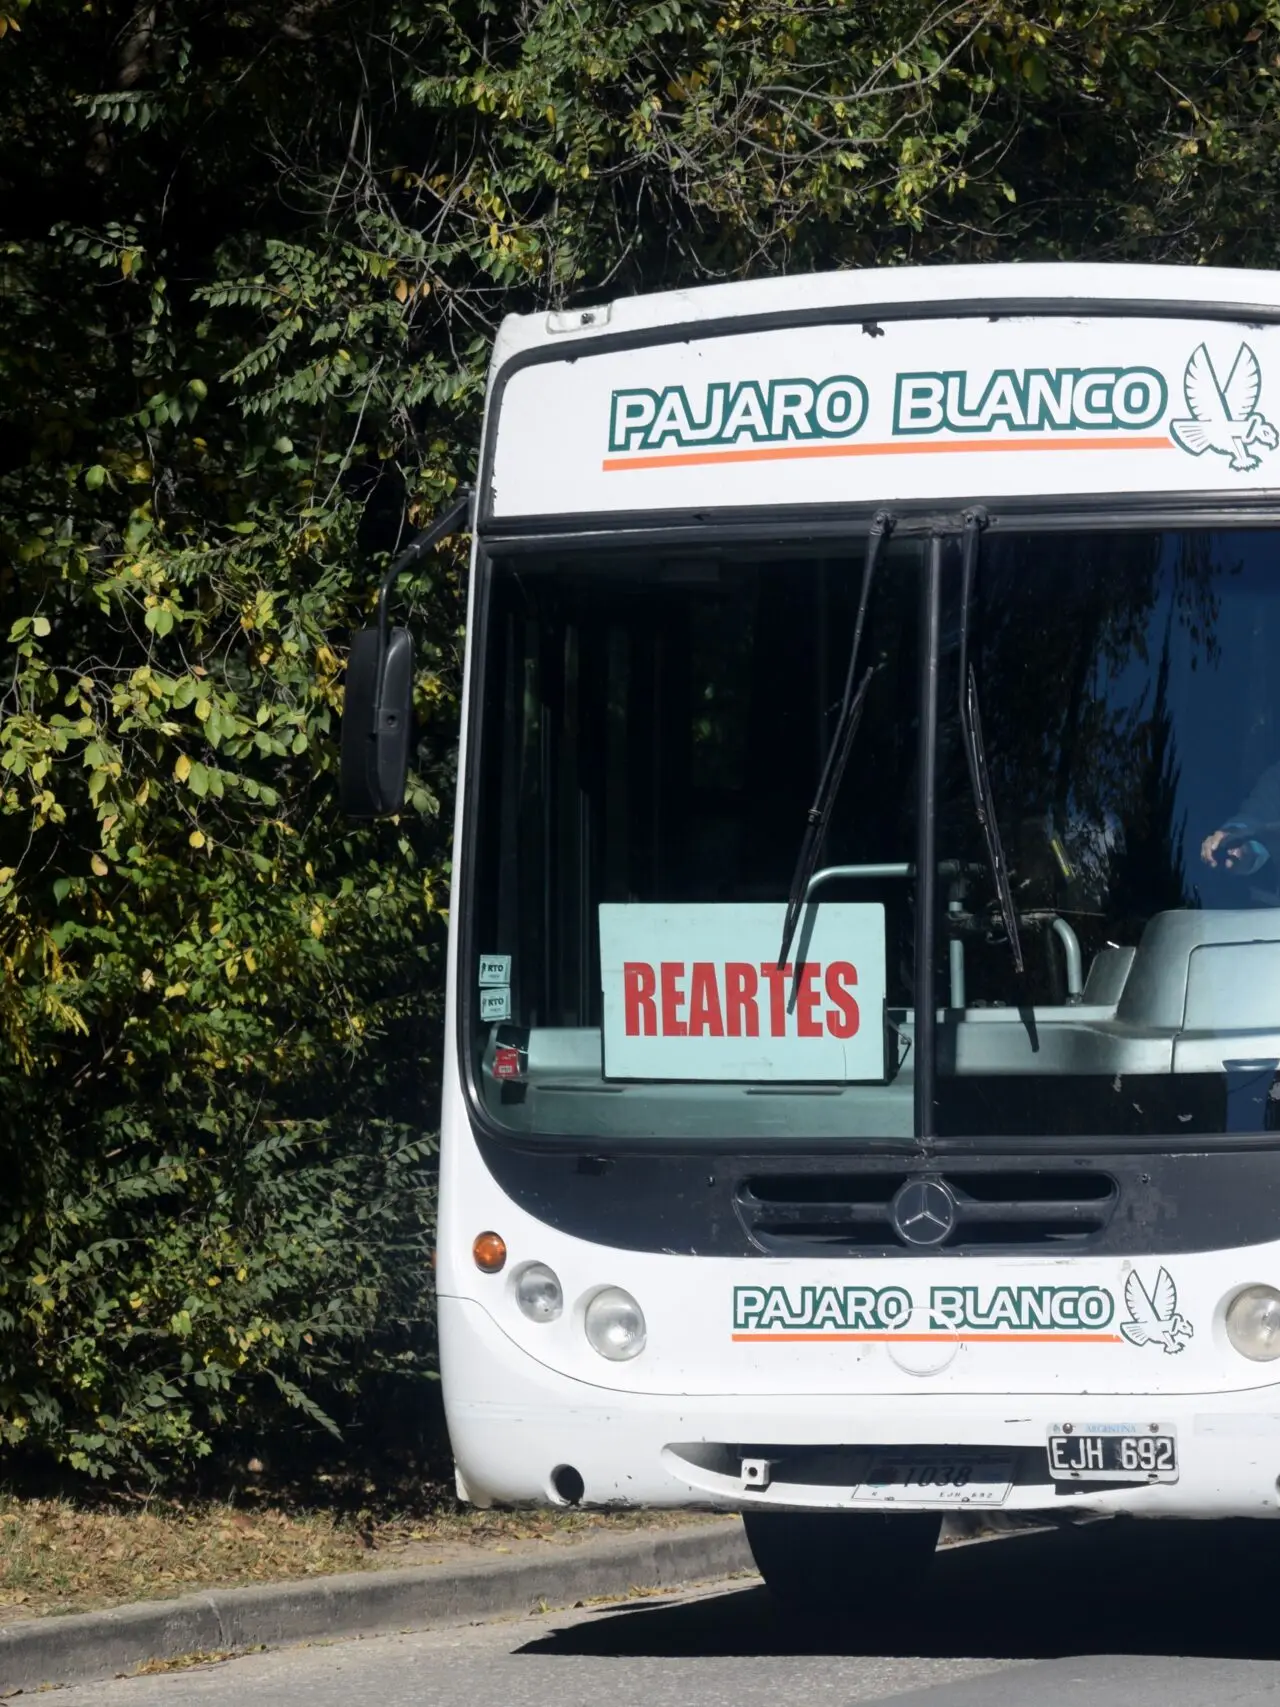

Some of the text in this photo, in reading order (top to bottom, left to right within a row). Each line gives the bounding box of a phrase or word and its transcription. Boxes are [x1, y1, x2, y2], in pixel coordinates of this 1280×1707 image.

[608, 366, 1168, 452] PAJARO BLANCO
[487, 964, 504, 973] RTO
[623, 960, 860, 1039] REARTES
[733, 1286, 1114, 1330] PAJARO BLANCO
[1084, 1423, 1137, 1433] ARGENTINA
[1051, 1437, 1174, 1470] EJH 692
[903, 1466, 973, 1487] 1038
